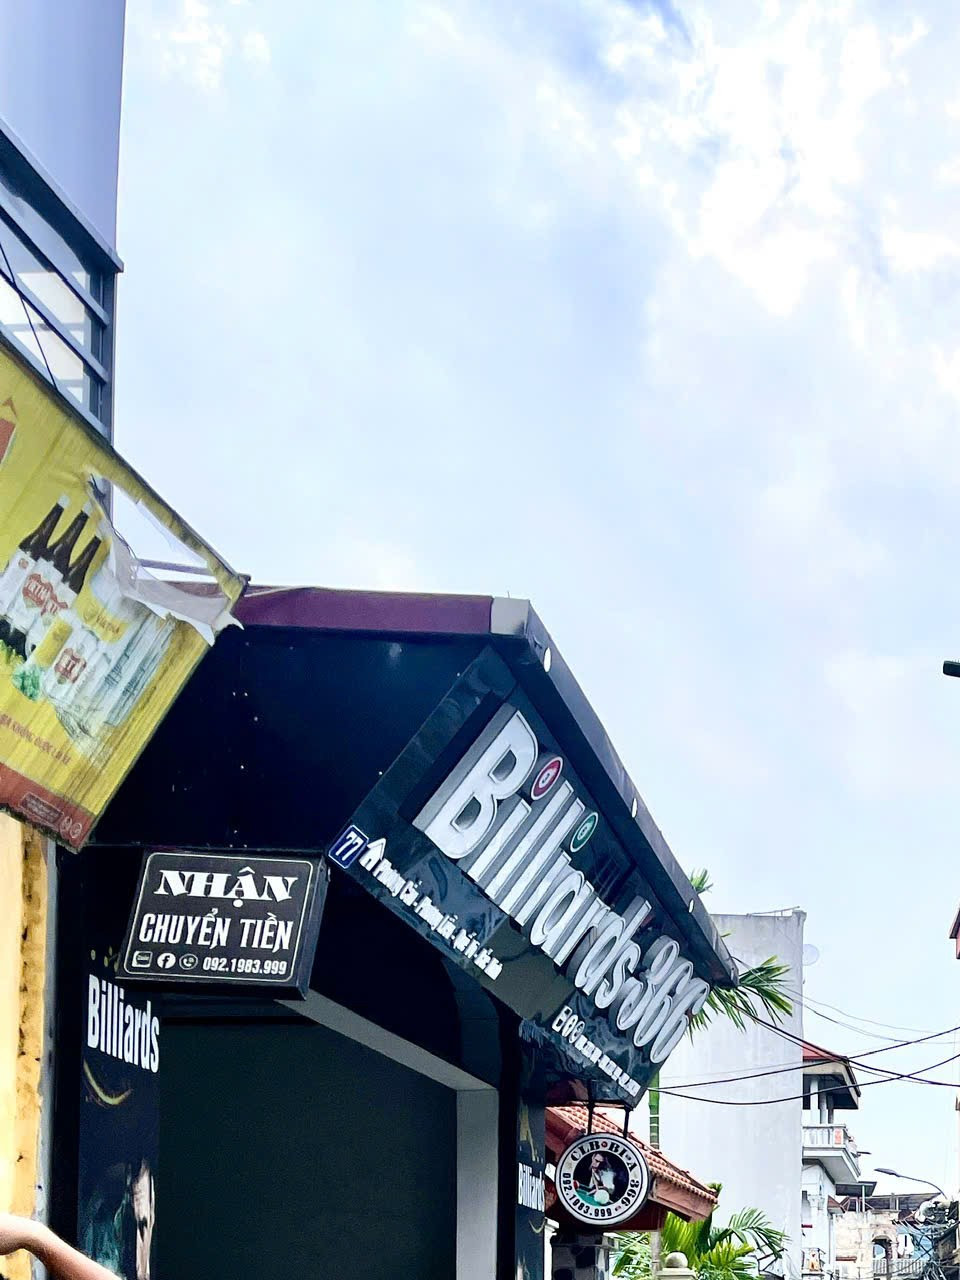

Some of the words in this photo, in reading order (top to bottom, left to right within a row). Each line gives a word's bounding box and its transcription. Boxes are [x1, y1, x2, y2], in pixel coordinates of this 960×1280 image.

[335, 830, 364, 861] 77
[412, 702, 652, 1008] Billiards
[153, 865, 299, 908] NHẬN
[138, 907, 231, 950] CHUYỂN
[239, 912, 294, 953] TIỀN
[202, 955, 288, 975] 092.1983.999
[87, 973, 160, 1073] Billiards
[570, 1140, 601, 1162] CLB
